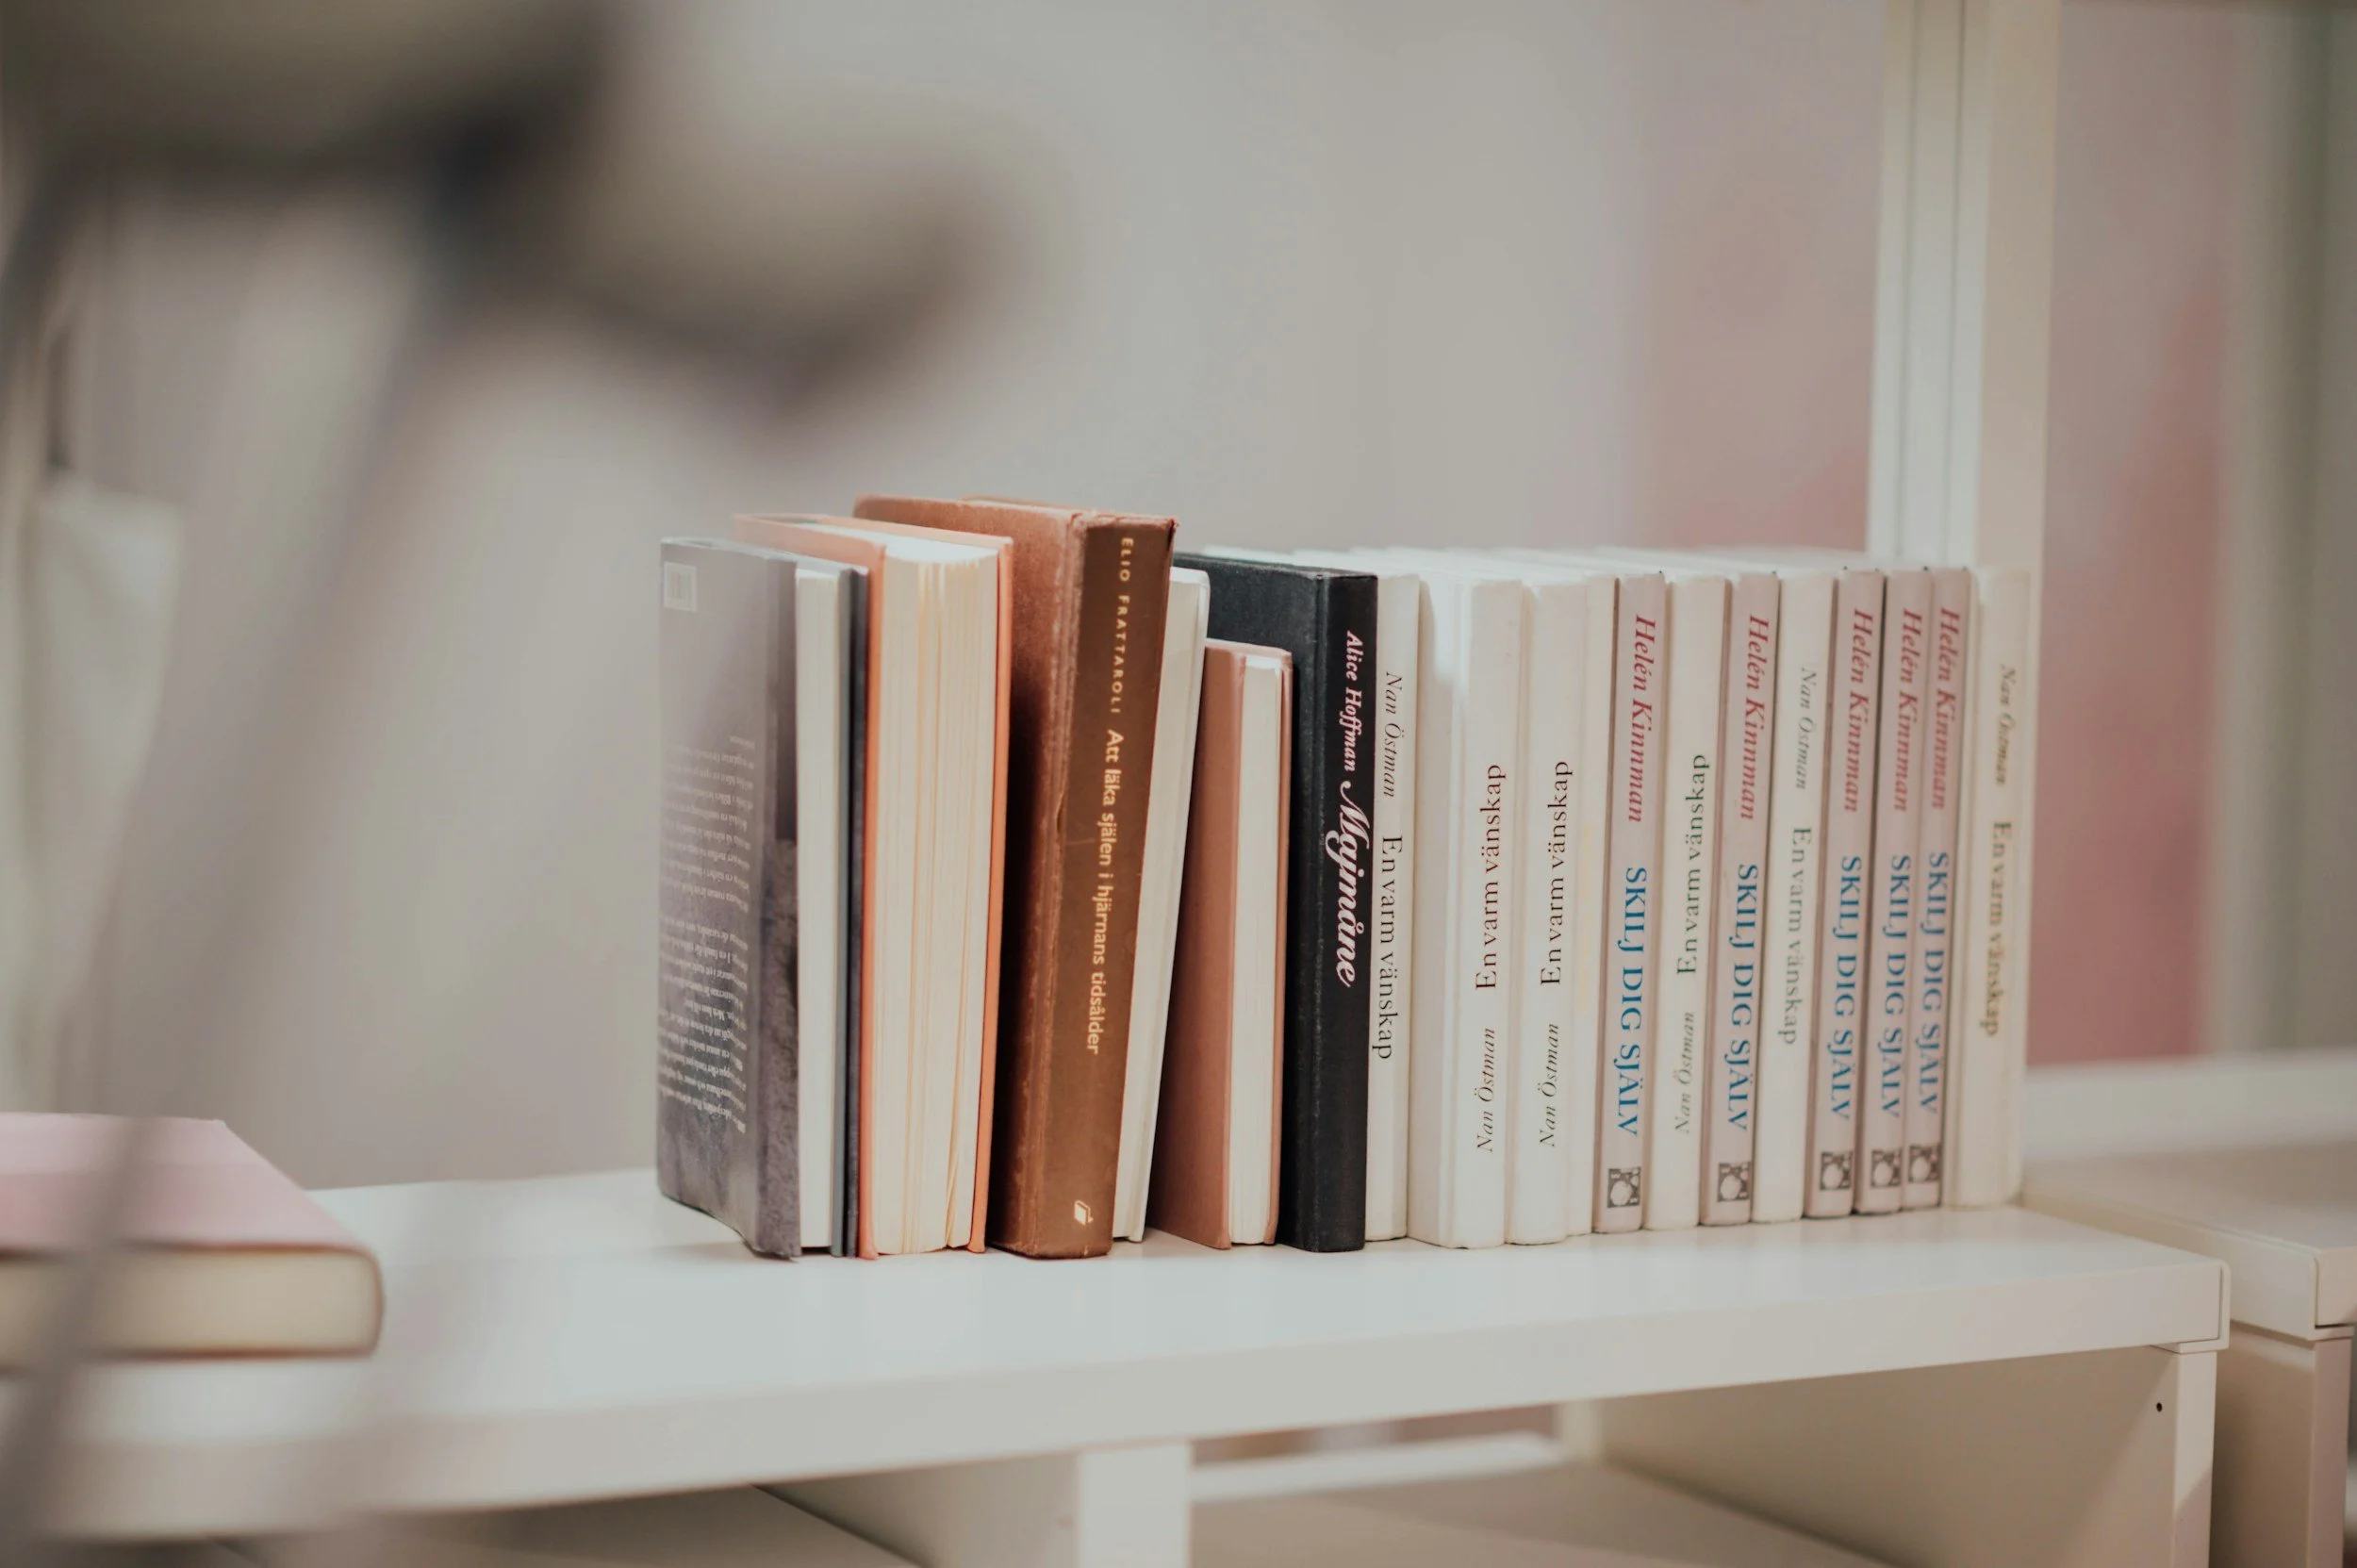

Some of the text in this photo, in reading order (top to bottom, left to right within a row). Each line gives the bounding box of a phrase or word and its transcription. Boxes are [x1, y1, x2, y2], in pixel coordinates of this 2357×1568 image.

[1111, 538, 1133, 713] ELIO FRATTAROLI
[1339, 631, 1363, 771] Alice Hoffman
[1629, 615, 1656, 821] Helén Kinnman
[1741, 616, 1769, 819] Helén Kinnman
[1845, 609, 1873, 812] Helén Kinnman
[1895, 609, 1922, 811] Helén Kinnman
[1930, 608, 1960, 808] Helén Kinnman
[2001, 666, 2016, 705] Nan
[1103, 769, 1121, 805] läka
[1106, 730, 1124, 762] Att
[1383, 672, 1404, 798] Nan Östman
[1796, 668, 1817, 789] Nan Östman
[1093, 885, 1113, 965] hjärnans
[1097, 813, 1116, 866] själen
[1326, 781, 1370, 987] Majmåne
[1476, 766, 1506, 988] En varm vänskap
[1541, 762, 1573, 983] En varm vänskap
[1677, 755, 1709, 973] En varm vänskap
[1087, 972, 1106, 1054] tidsålder
[1372, 835, 1403, 1059] En varm vänskap
[1614, 868, 1646, 1134] SKILJ DIG SJÄLV
[1726, 865, 1757, 1131] SKILJ DIG SJÄLV
[1778, 941, 1803, 1044] vänskap
[1828, 857, 1861, 1121] SKILJ DIG SJÄLV
[1878, 856, 1910, 1118] SKILJ DIG SJÄLV
[1916, 852, 1948, 1114] SKILJ DIG SJÄLV
[1980, 933, 2003, 1036] vänskap
[1475, 1029, 1494, 1151] Nan Östman
[1538, 1024, 1558, 1147] Nan Östman
[1673, 1013, 1693, 1133] Nan Östman
